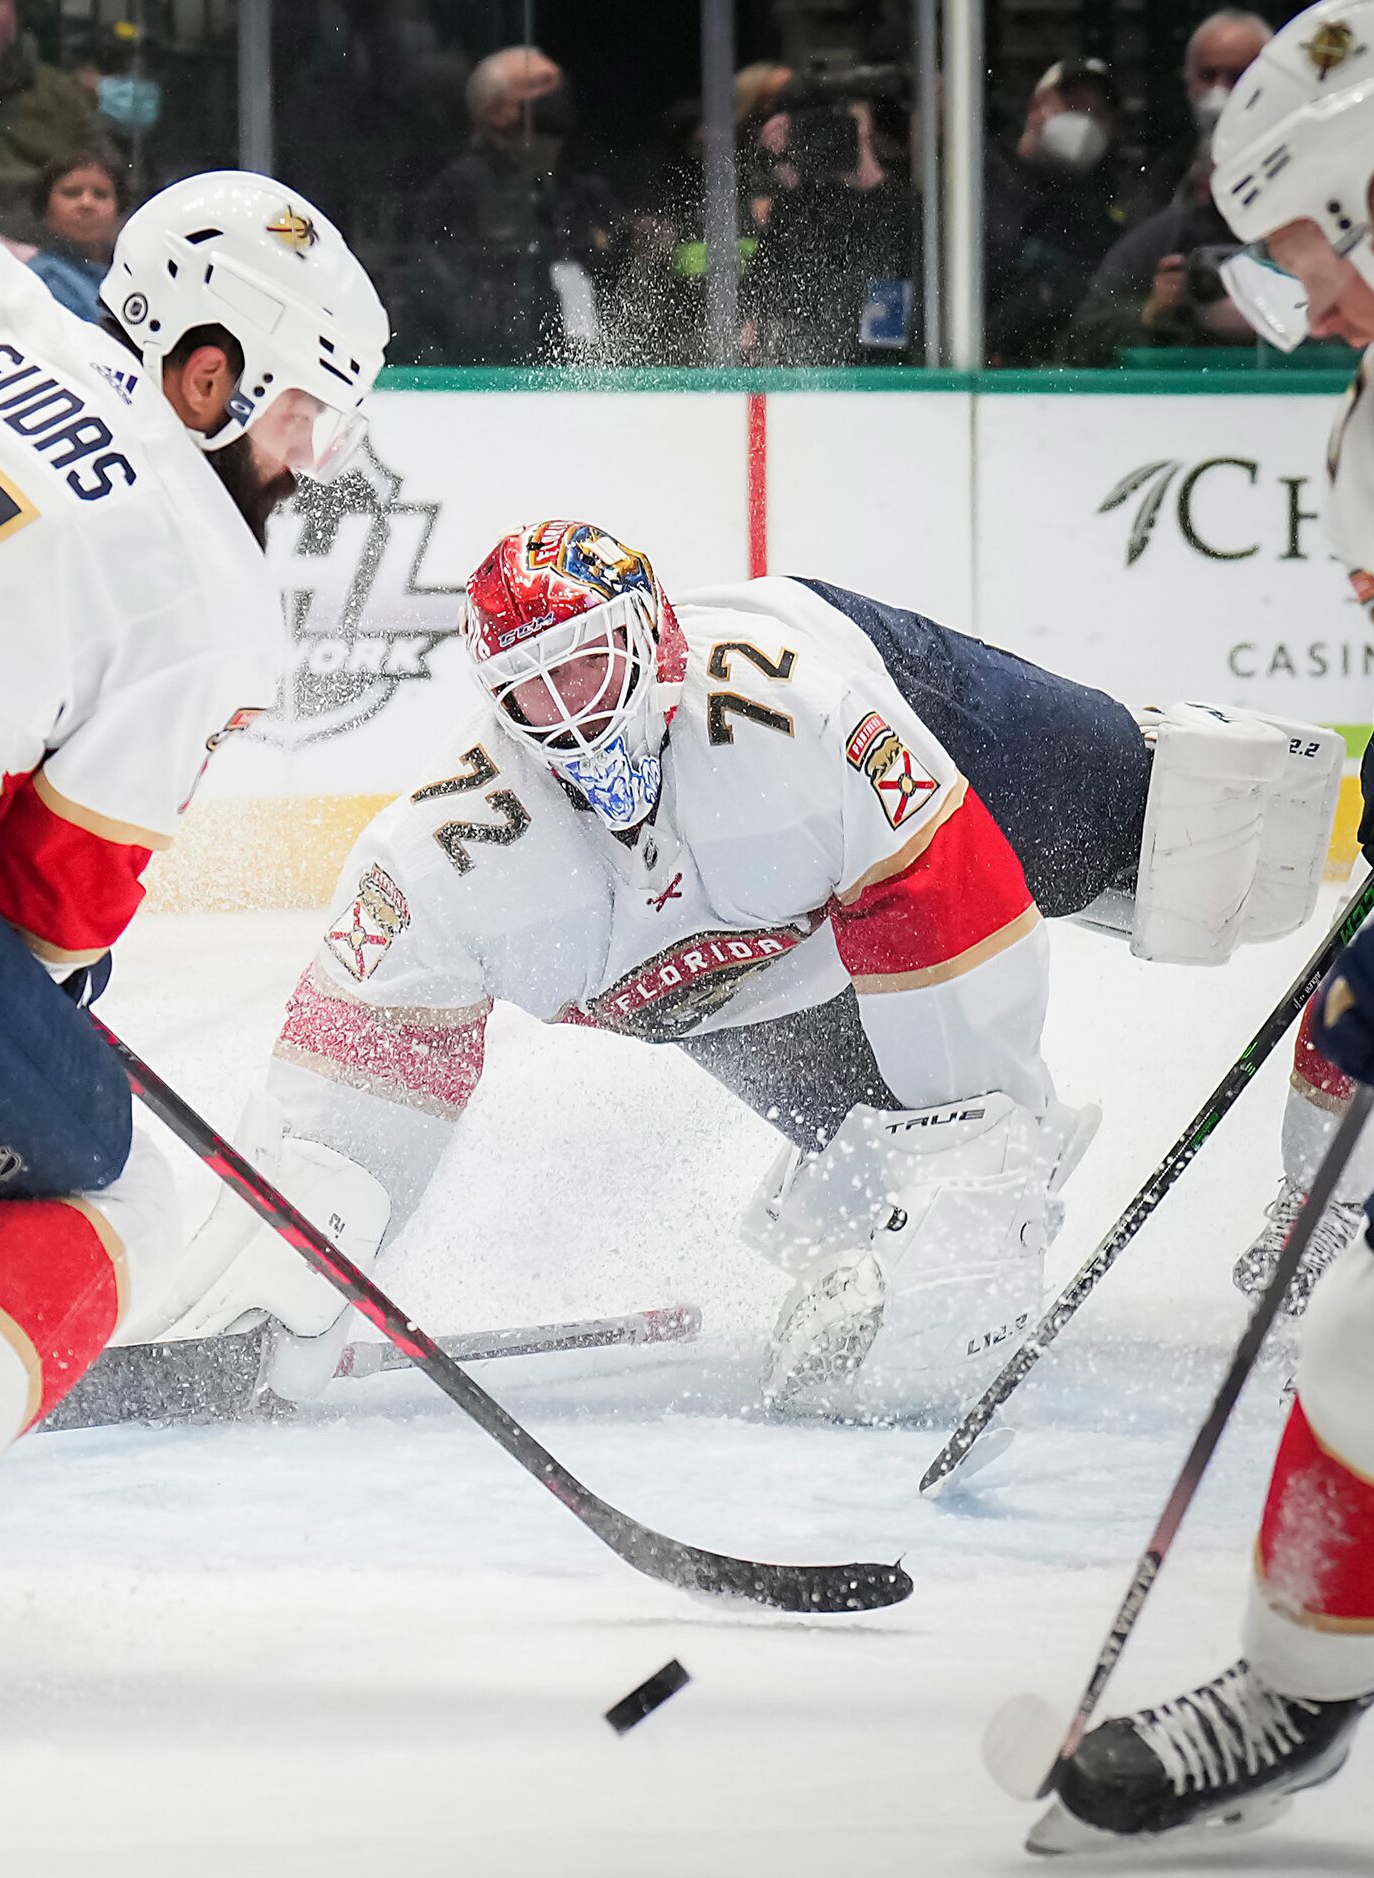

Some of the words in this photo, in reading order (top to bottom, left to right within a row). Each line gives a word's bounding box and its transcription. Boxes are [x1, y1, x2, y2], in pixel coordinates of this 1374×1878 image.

[89, 362, 132, 405] adidas
[498, 611, 554, 647] CCM
[706, 641, 799, 747] 72
[1289, 738, 1321, 758] 2.2
[410, 742, 532, 878] 72
[613, 937, 784, 1014] FLORIDA
[885, 1108, 986, 1135] TRUE
